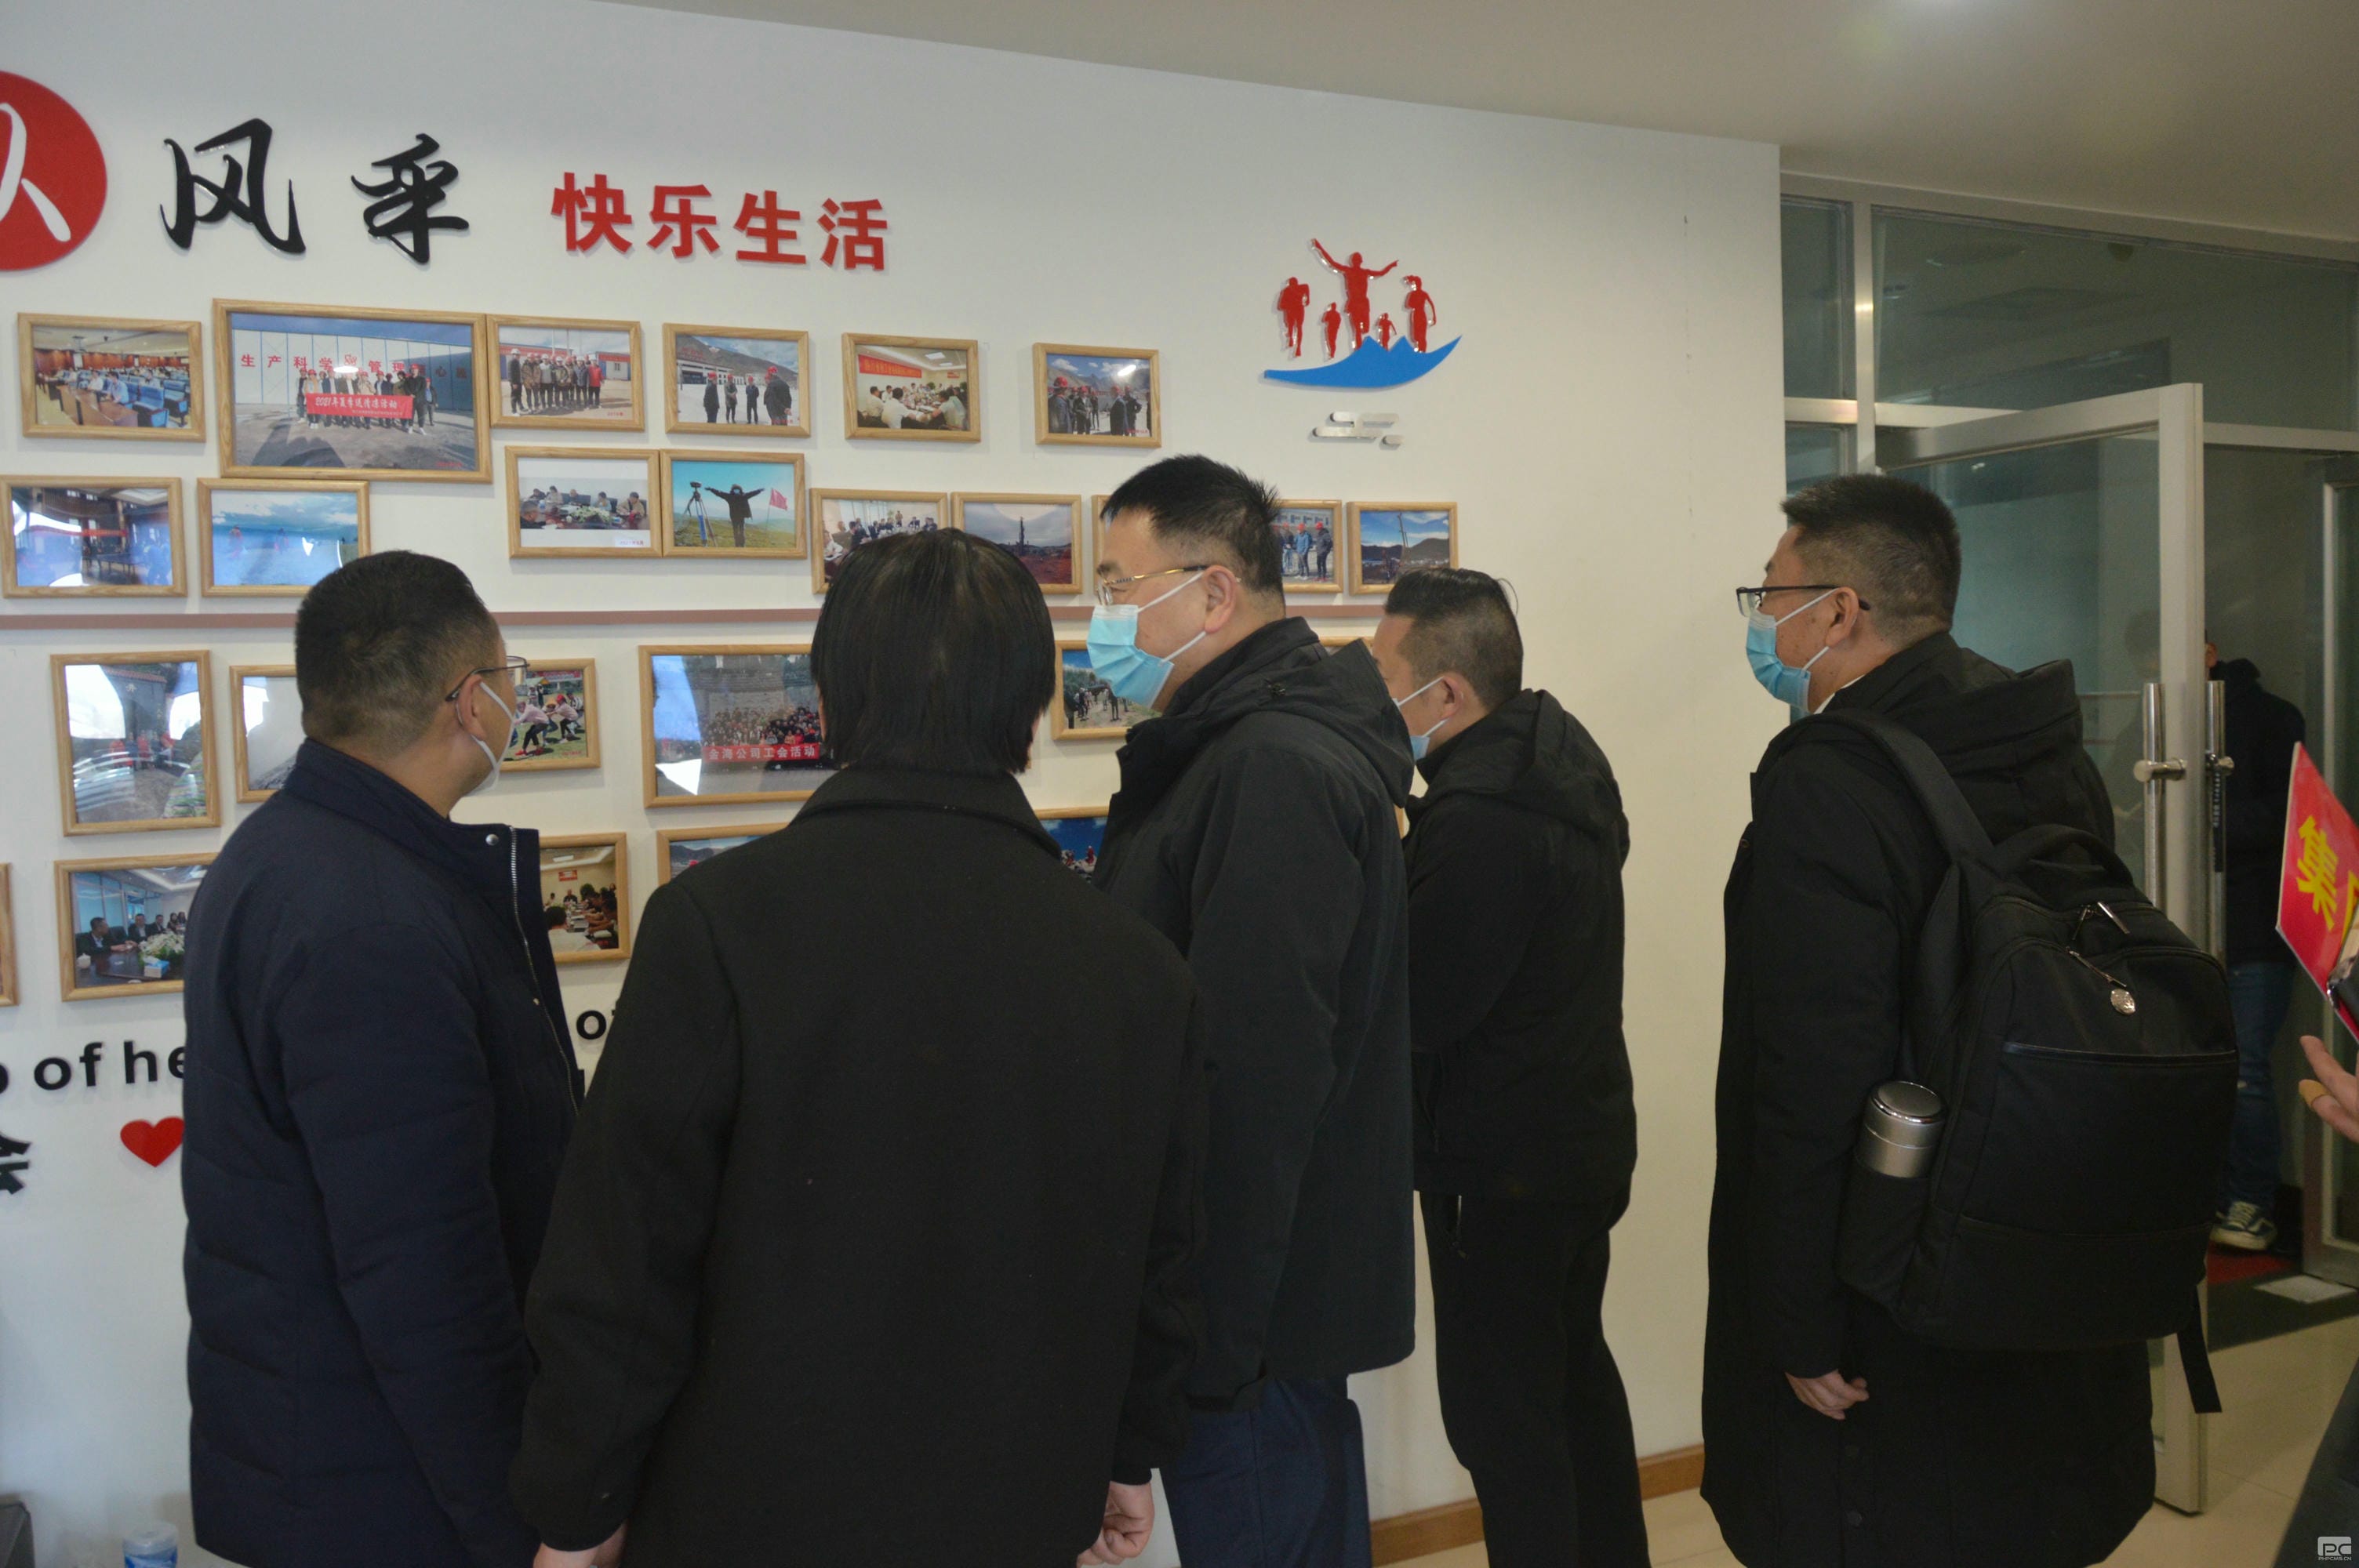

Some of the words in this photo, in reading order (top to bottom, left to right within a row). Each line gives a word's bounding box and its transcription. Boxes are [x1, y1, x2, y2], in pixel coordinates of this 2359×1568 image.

[551, 172, 888, 270] 快乐生活
[2296, 815, 2359, 945] 集
[34, 1041, 104, 1091] of
[576, 1009, 615, 1040] o
